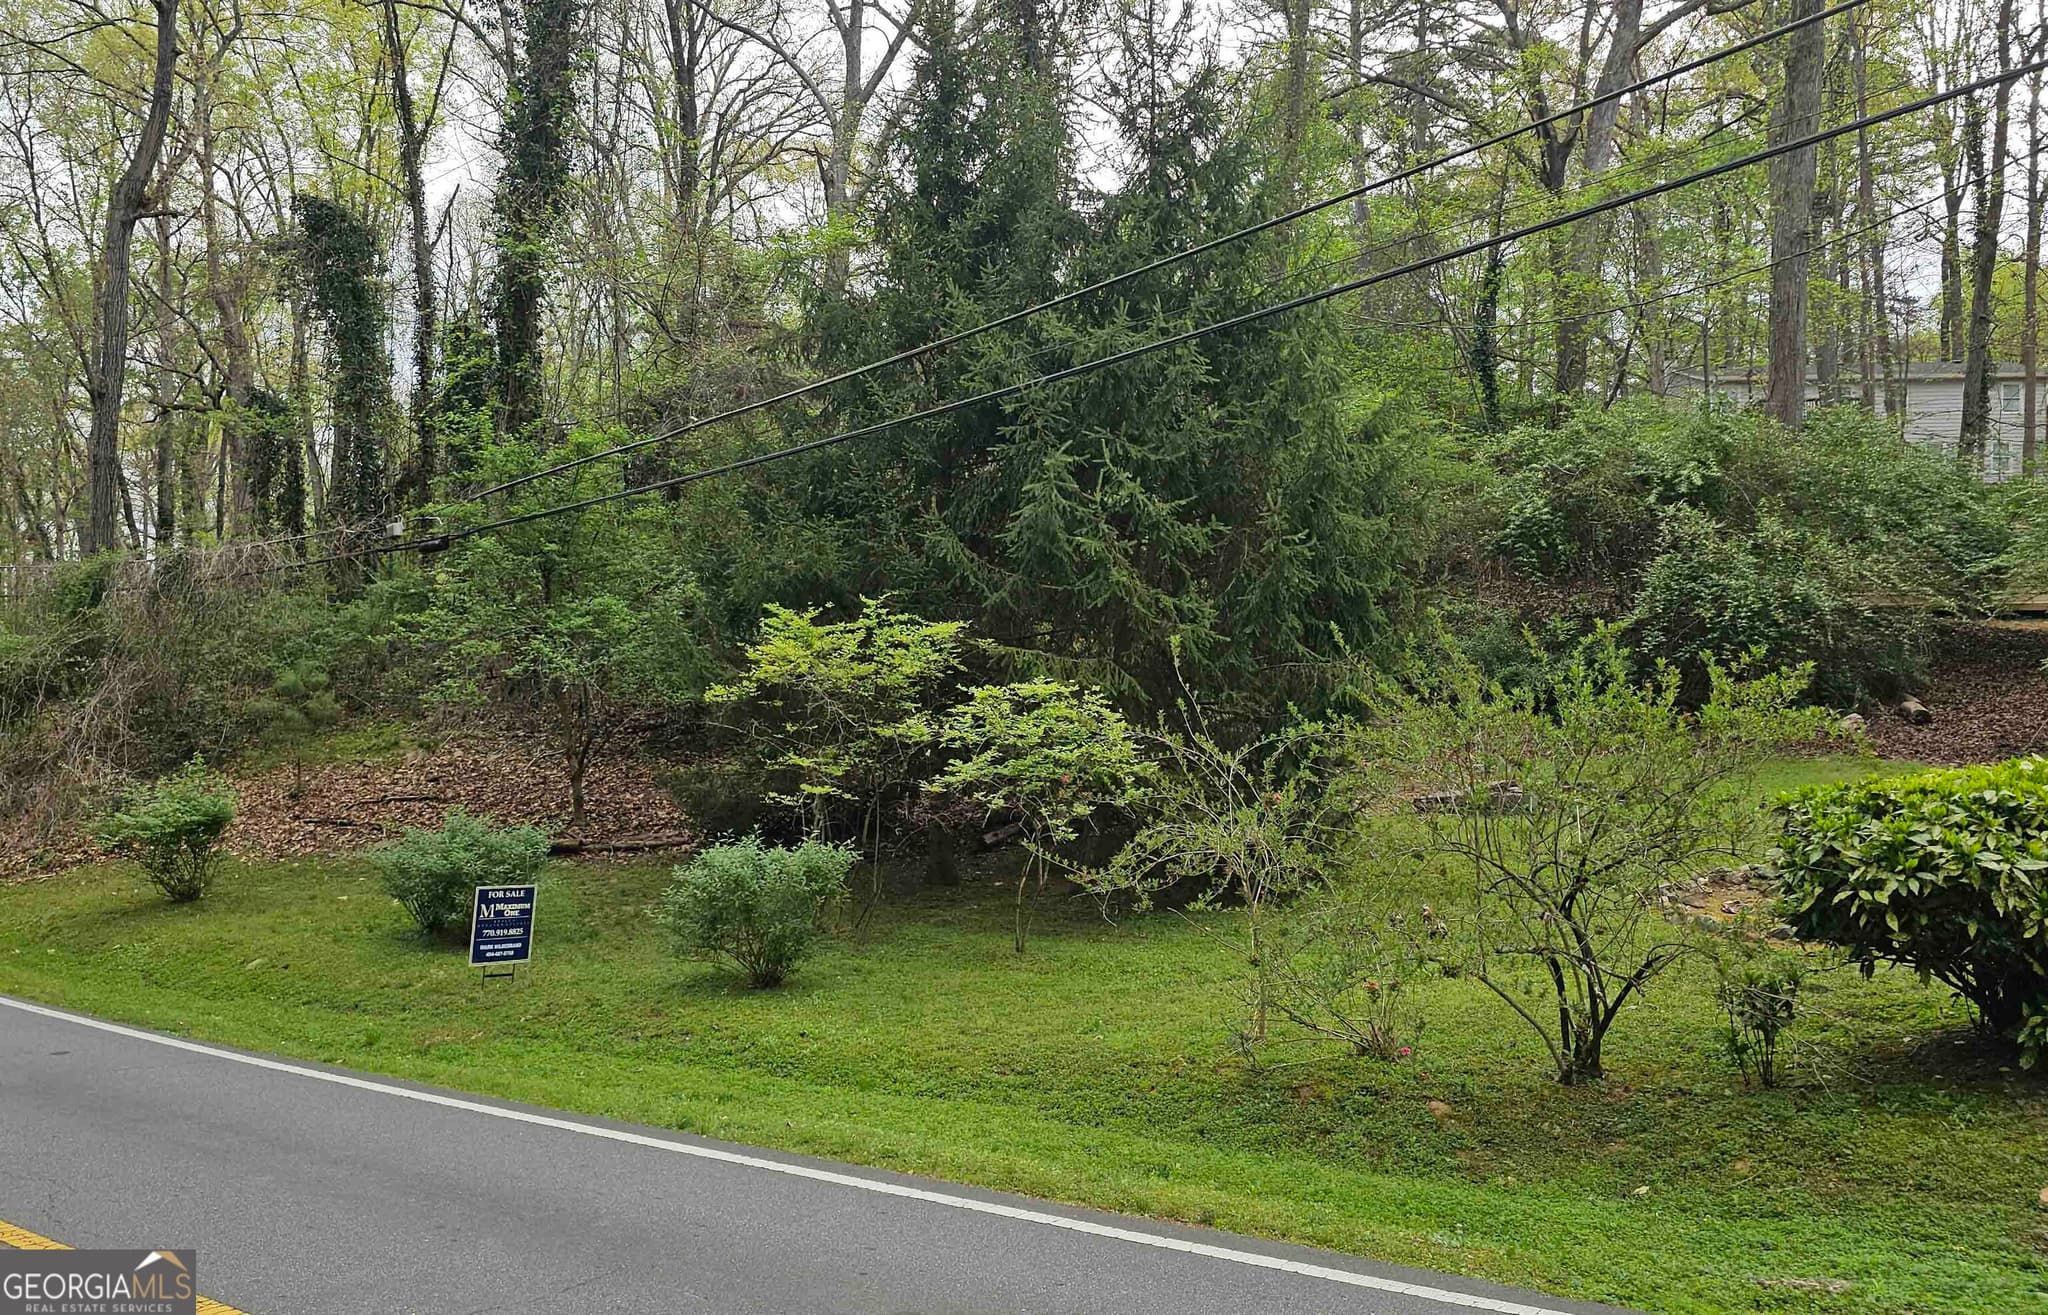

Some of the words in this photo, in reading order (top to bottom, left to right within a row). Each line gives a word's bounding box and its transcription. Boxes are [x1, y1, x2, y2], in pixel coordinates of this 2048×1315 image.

[488, 890, 504, 898] FOR
[505, 890, 526, 898] SALE
[480, 904, 495, 918] M
